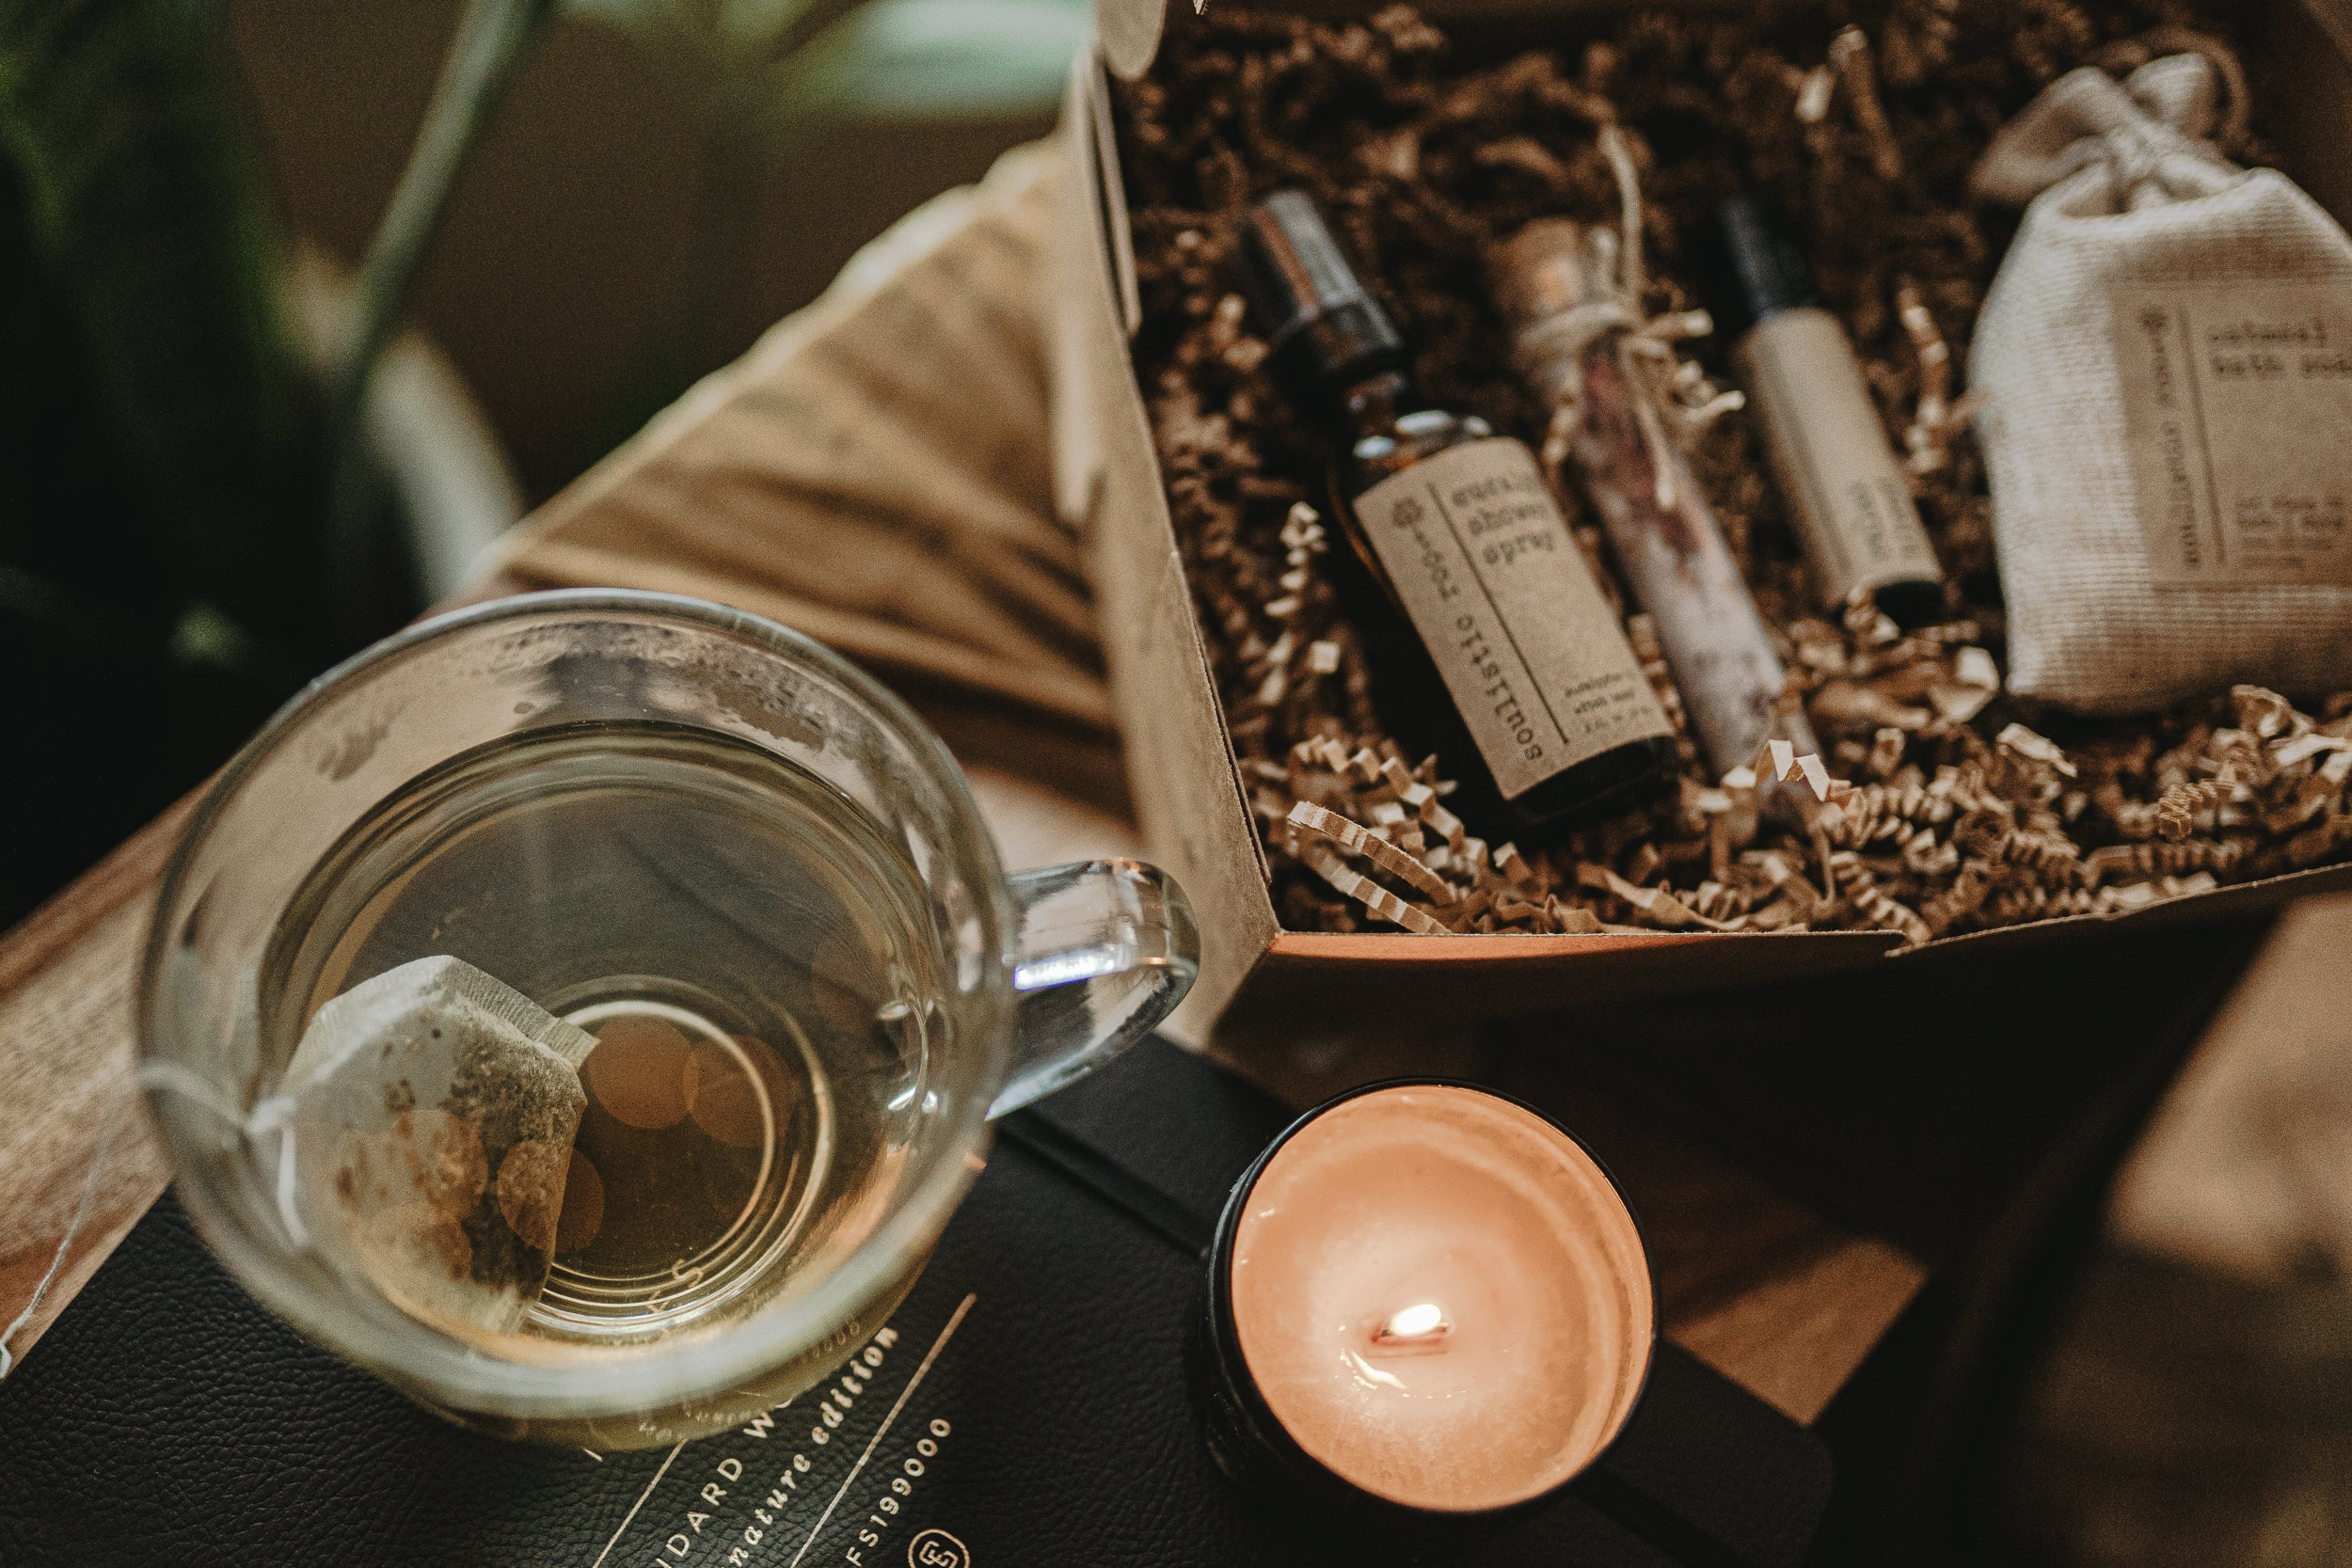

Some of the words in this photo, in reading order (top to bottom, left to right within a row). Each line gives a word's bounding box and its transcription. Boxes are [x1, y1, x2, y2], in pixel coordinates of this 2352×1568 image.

[1455, 614, 1543, 761] soulistic
[656, 1458, 743, 1568] DARD
[723, 1454, 811, 1568] nature
[811, 1327, 898, 1445] edition
[846, 1418, 951, 1566] FS199000
